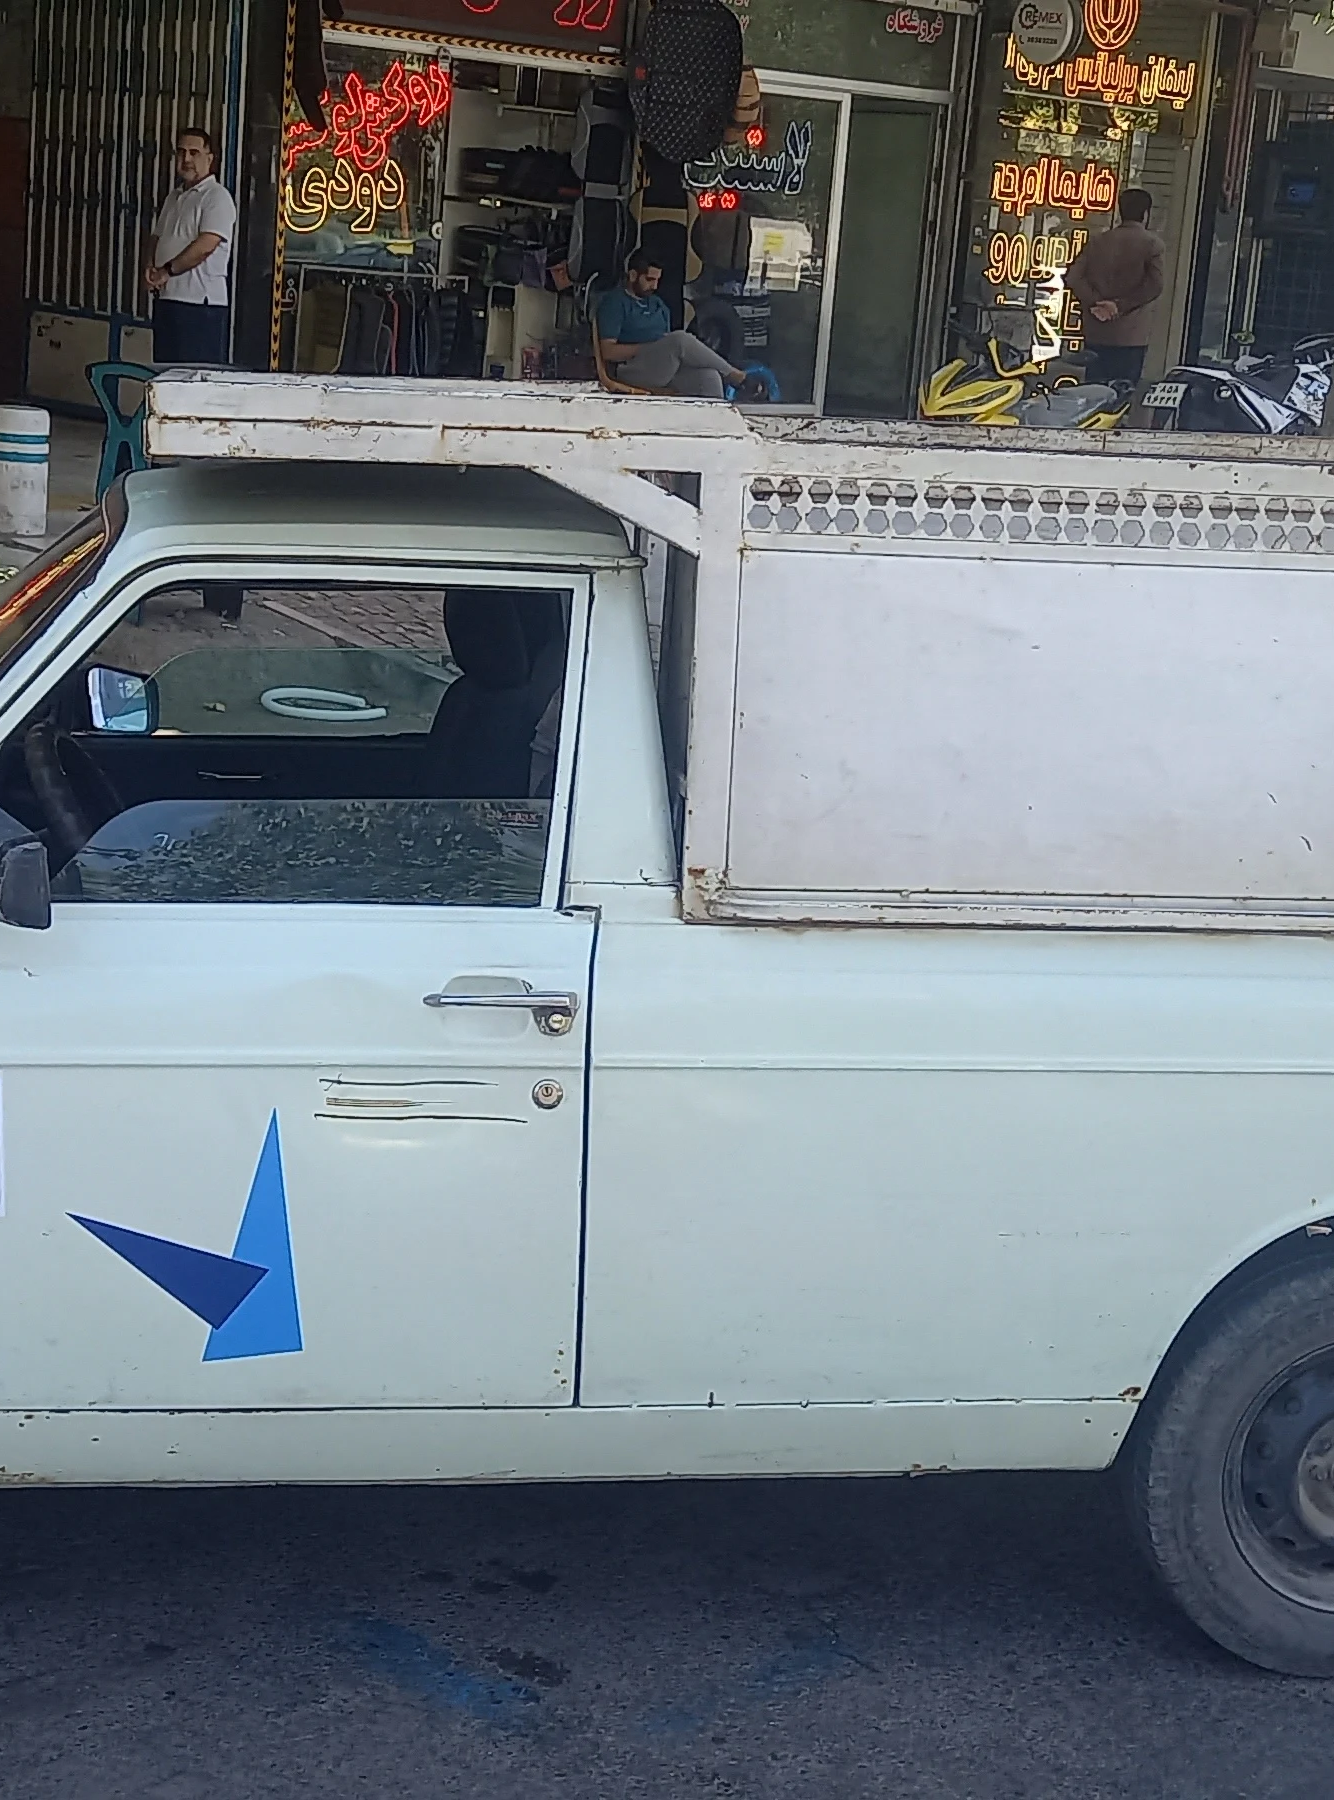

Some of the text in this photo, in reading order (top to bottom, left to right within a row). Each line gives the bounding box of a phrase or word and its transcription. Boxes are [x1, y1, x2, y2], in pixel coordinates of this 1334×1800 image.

[1024, 11, 1063, 24] REMEX
[1140, 55, 1196, 110] لیفان
[284, 158, 405, 232] دودی
